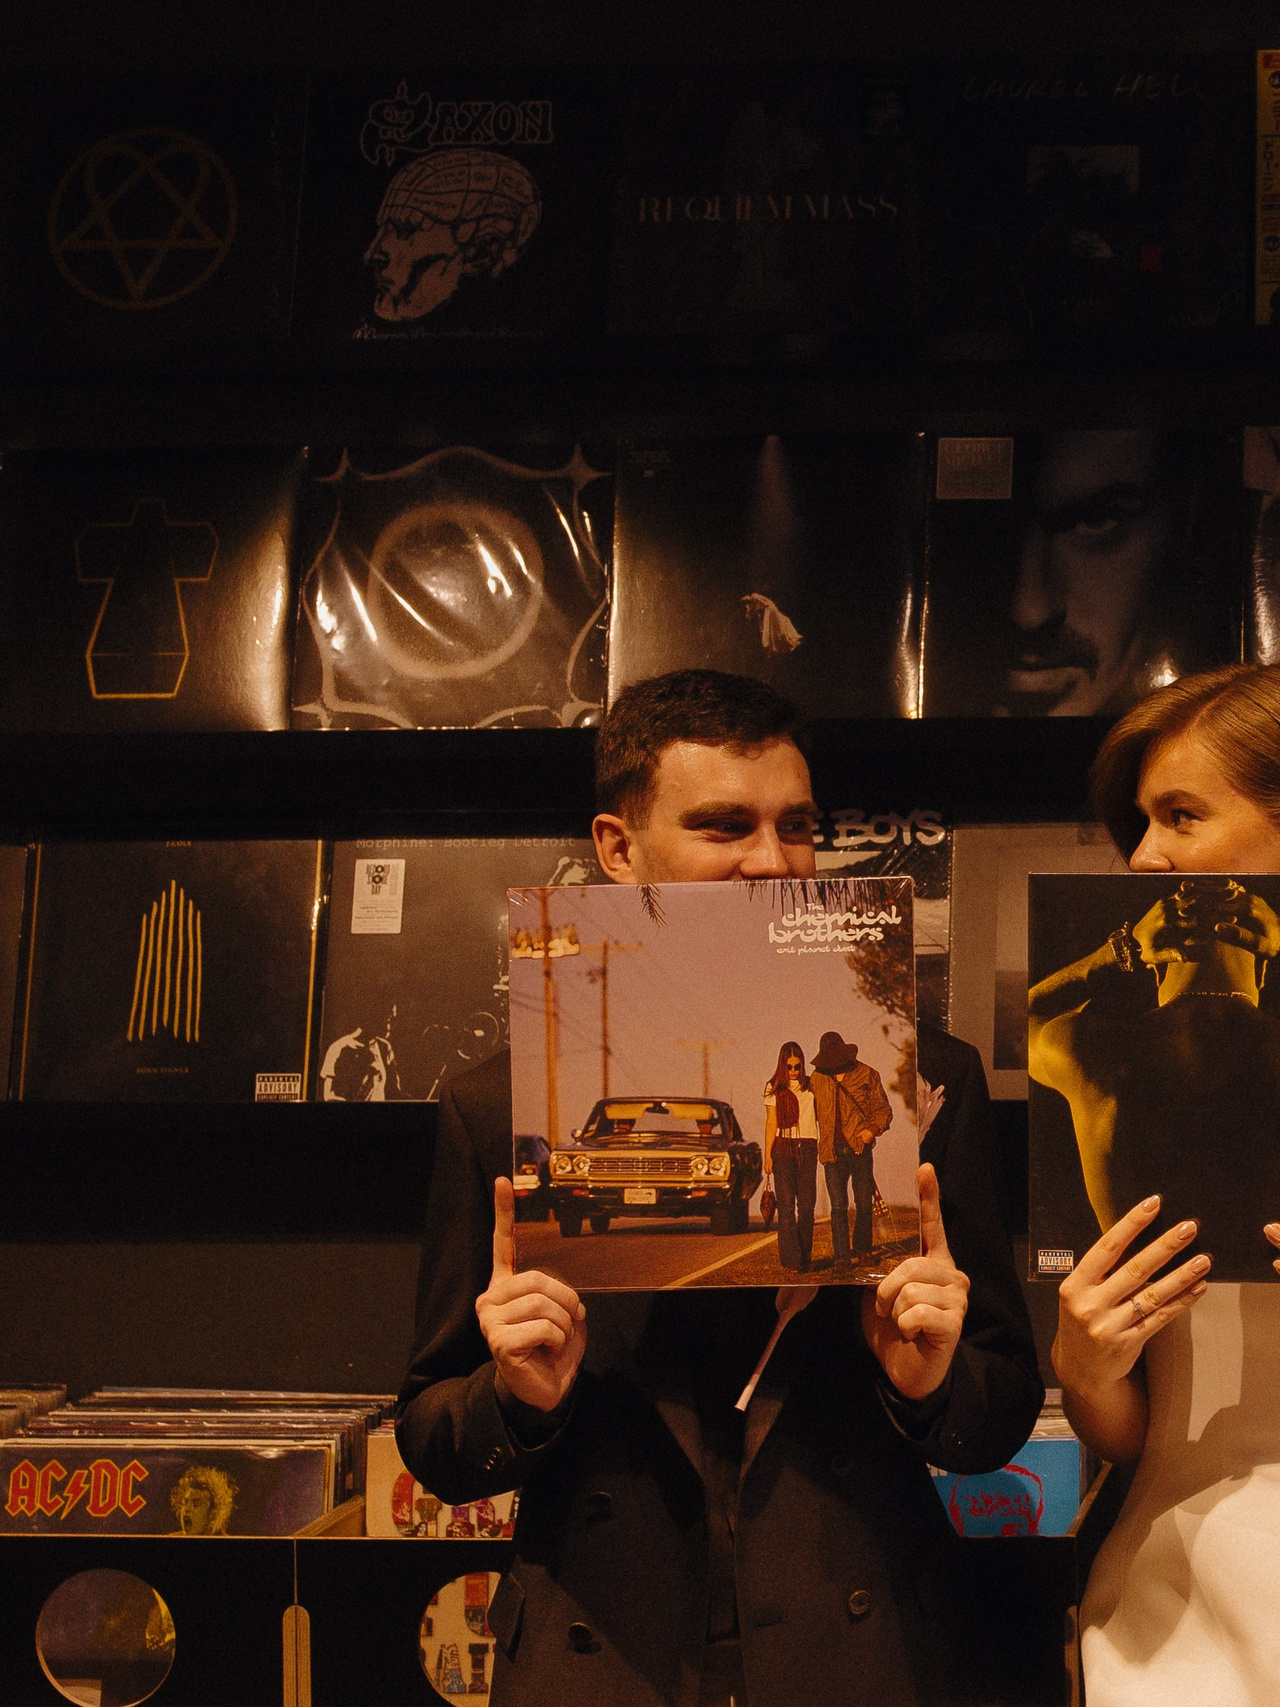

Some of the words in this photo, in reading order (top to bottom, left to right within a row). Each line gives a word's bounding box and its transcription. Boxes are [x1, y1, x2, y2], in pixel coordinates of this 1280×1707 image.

[360, 77, 554, 168] SAXON
[443, 838, 506, 850] Bootleg
[515, 838, 577, 849] Detroit
[807, 903, 824, 911] The
[781, 904, 902, 927] chemical
[768, 921, 885, 944] brothers
[798, 945, 831, 956] planet
[833, 944, 857, 953] dust
[258, 1082, 297, 1092] ADVISORY
